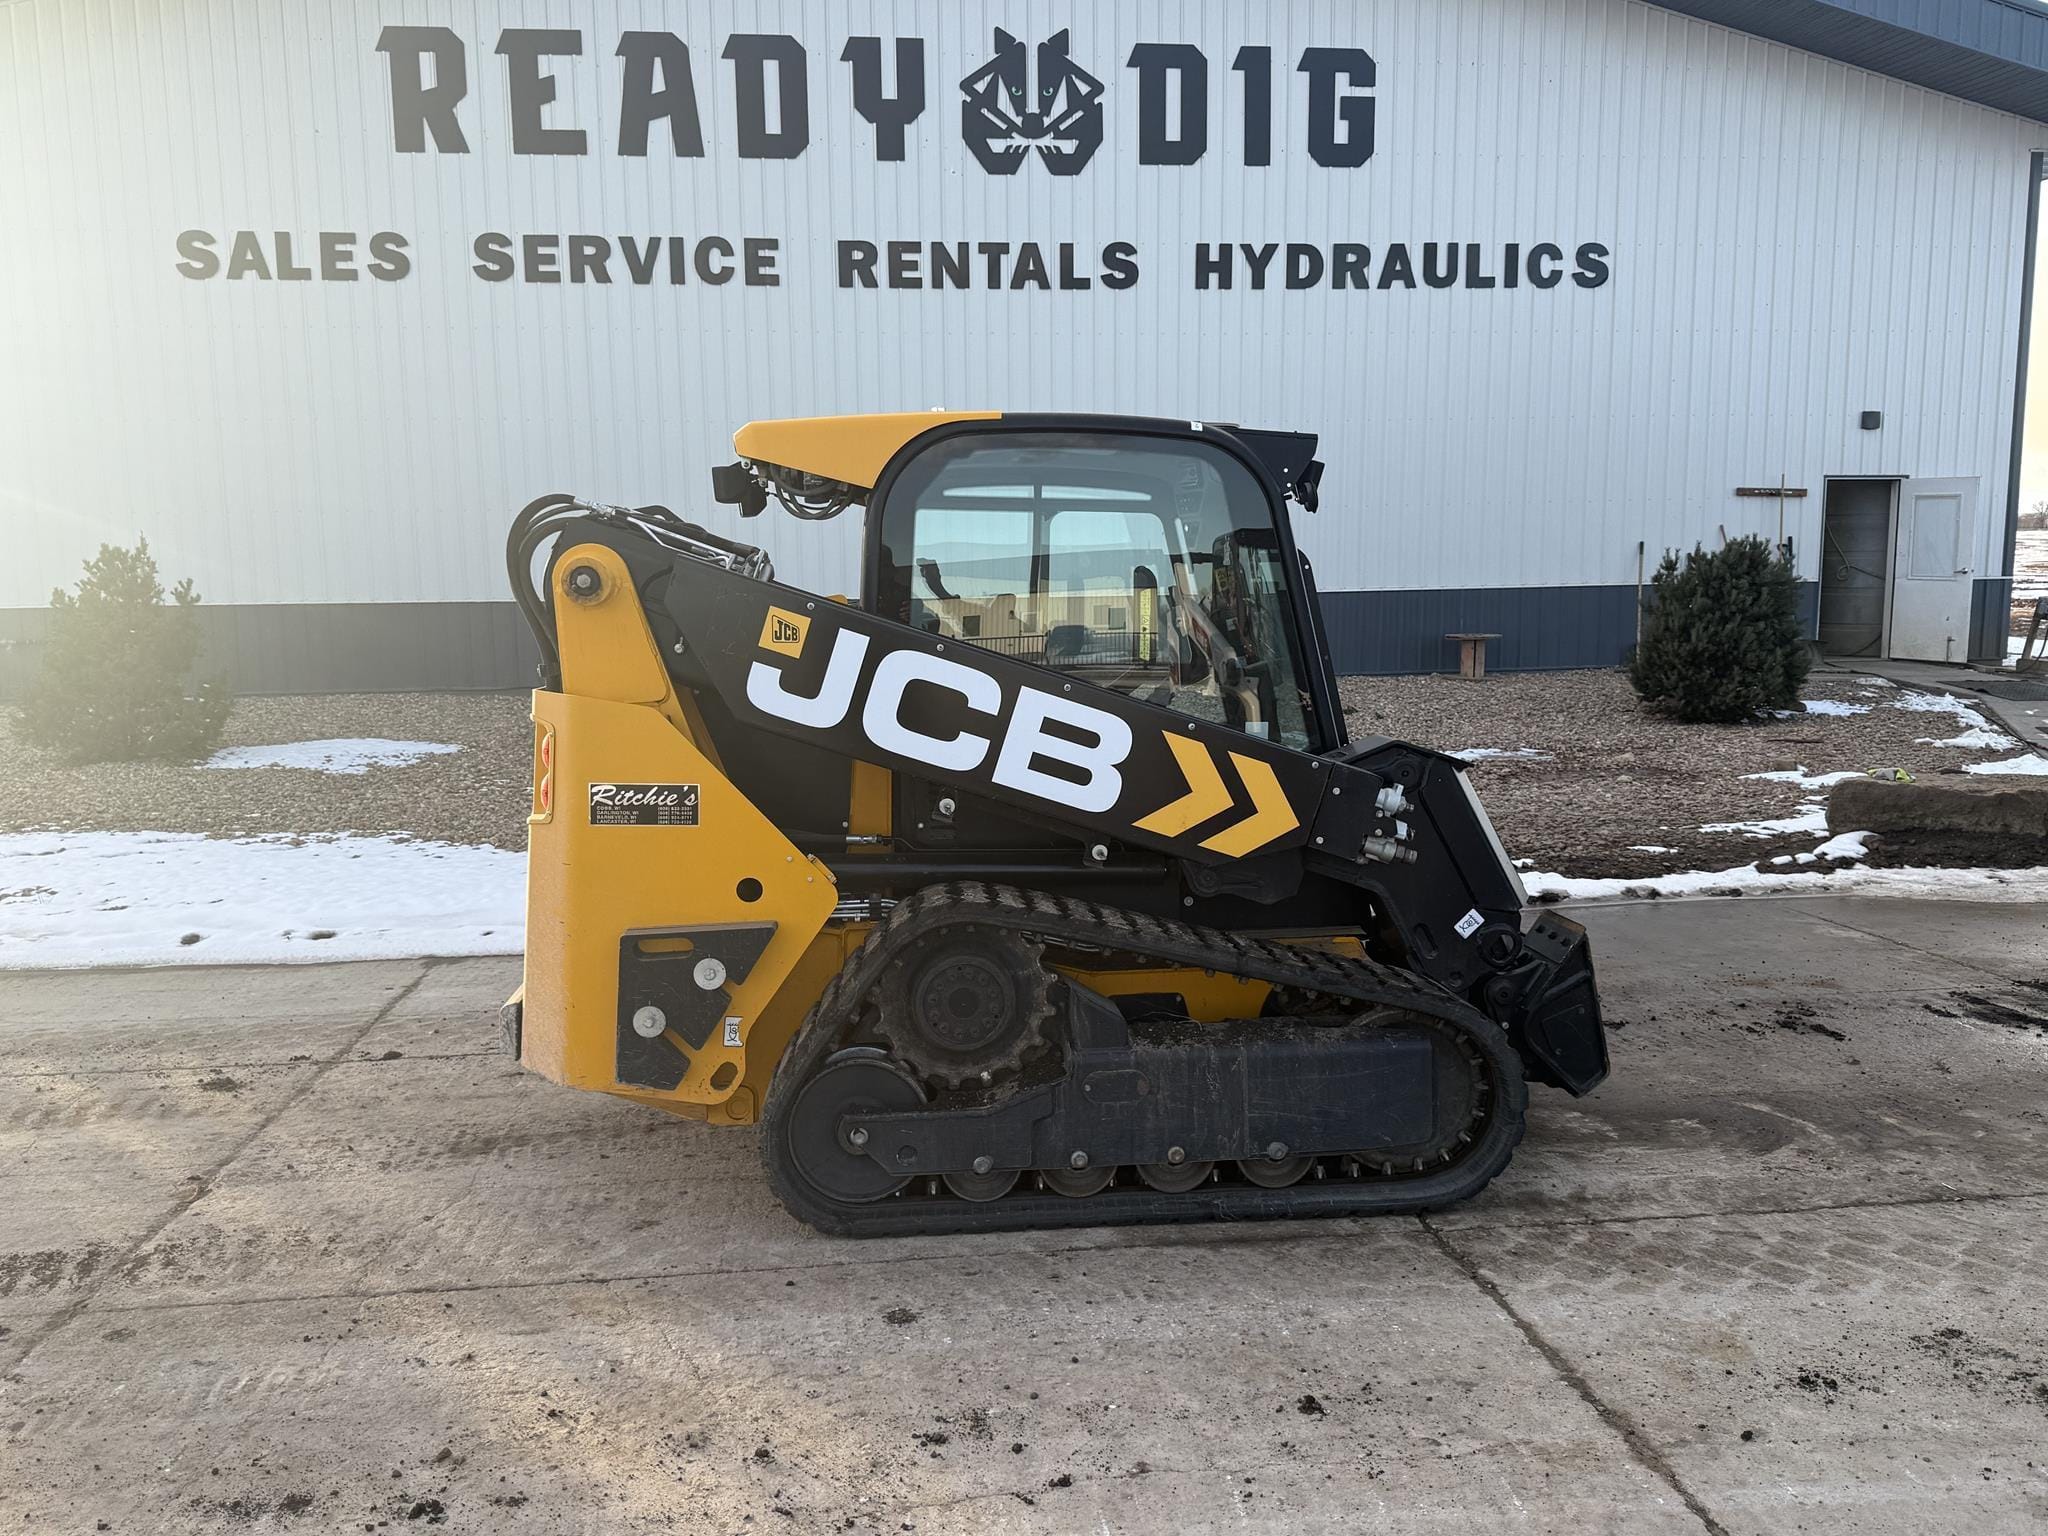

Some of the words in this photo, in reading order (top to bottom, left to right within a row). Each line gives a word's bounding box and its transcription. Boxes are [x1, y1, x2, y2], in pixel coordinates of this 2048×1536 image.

[375, 25, 926, 162] READY
[1126, 42, 1376, 168] DIG
[175, 229, 411, 283] SALES
[472, 232, 780, 287] SERVICE
[837, 239, 1140, 291] RENTALS
[1195, 242, 1611, 290] HYDRAULICS
[773, 617, 799, 642] JCB
[746, 627, 1133, 813] JCB
[591, 785, 698, 806] Ritchie's
